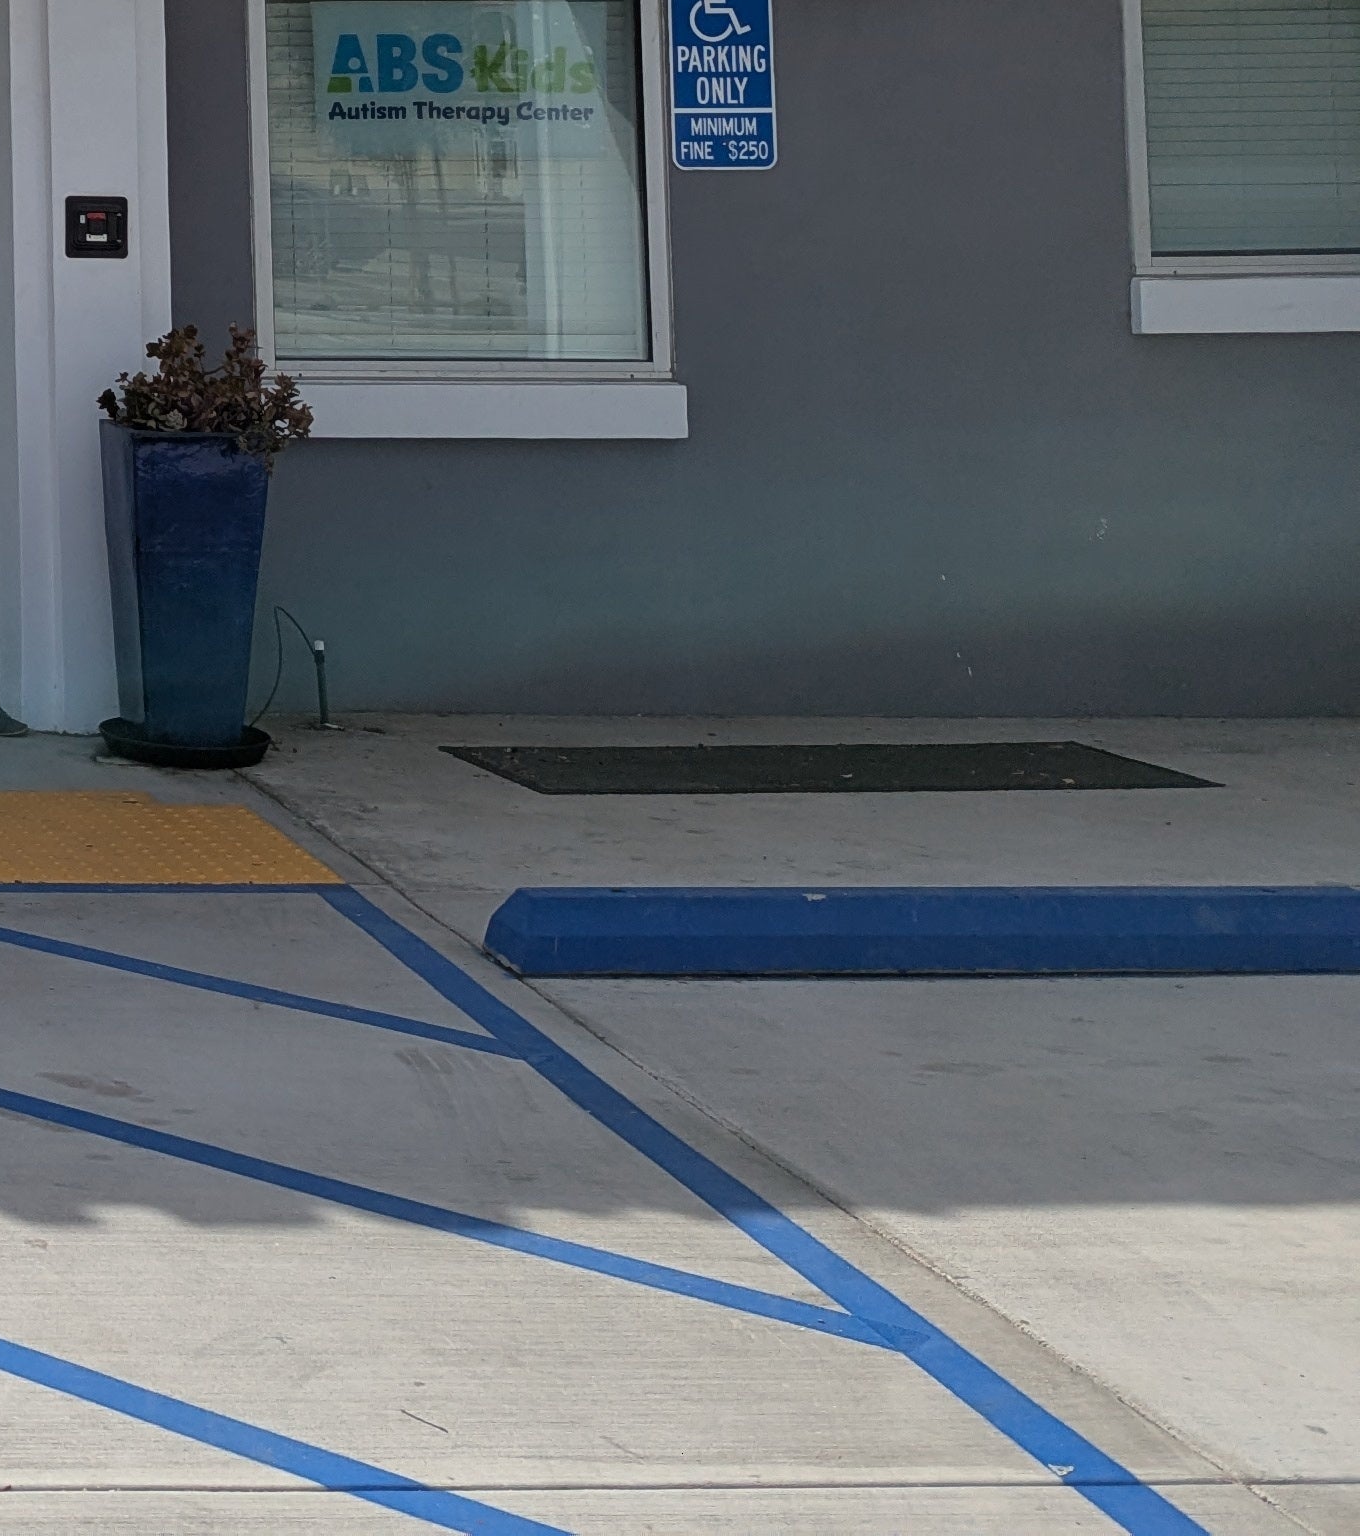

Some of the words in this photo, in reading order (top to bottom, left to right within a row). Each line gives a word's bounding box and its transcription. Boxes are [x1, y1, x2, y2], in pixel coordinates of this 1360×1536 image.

[327, 33, 464, 94] ABS
[470, 40, 595, 94] Kids
[677, 45, 766, 73] PARKING
[696, 77, 748, 104] ONLY
[328, 101, 407, 121] Autism
[412, 101, 509, 126] Therapy
[516, 101, 594, 121] Center
[690, 117, 757, 136] MINIMUM
[680, 141, 714, 160] FINE
[728, 140, 769, 161] $250
